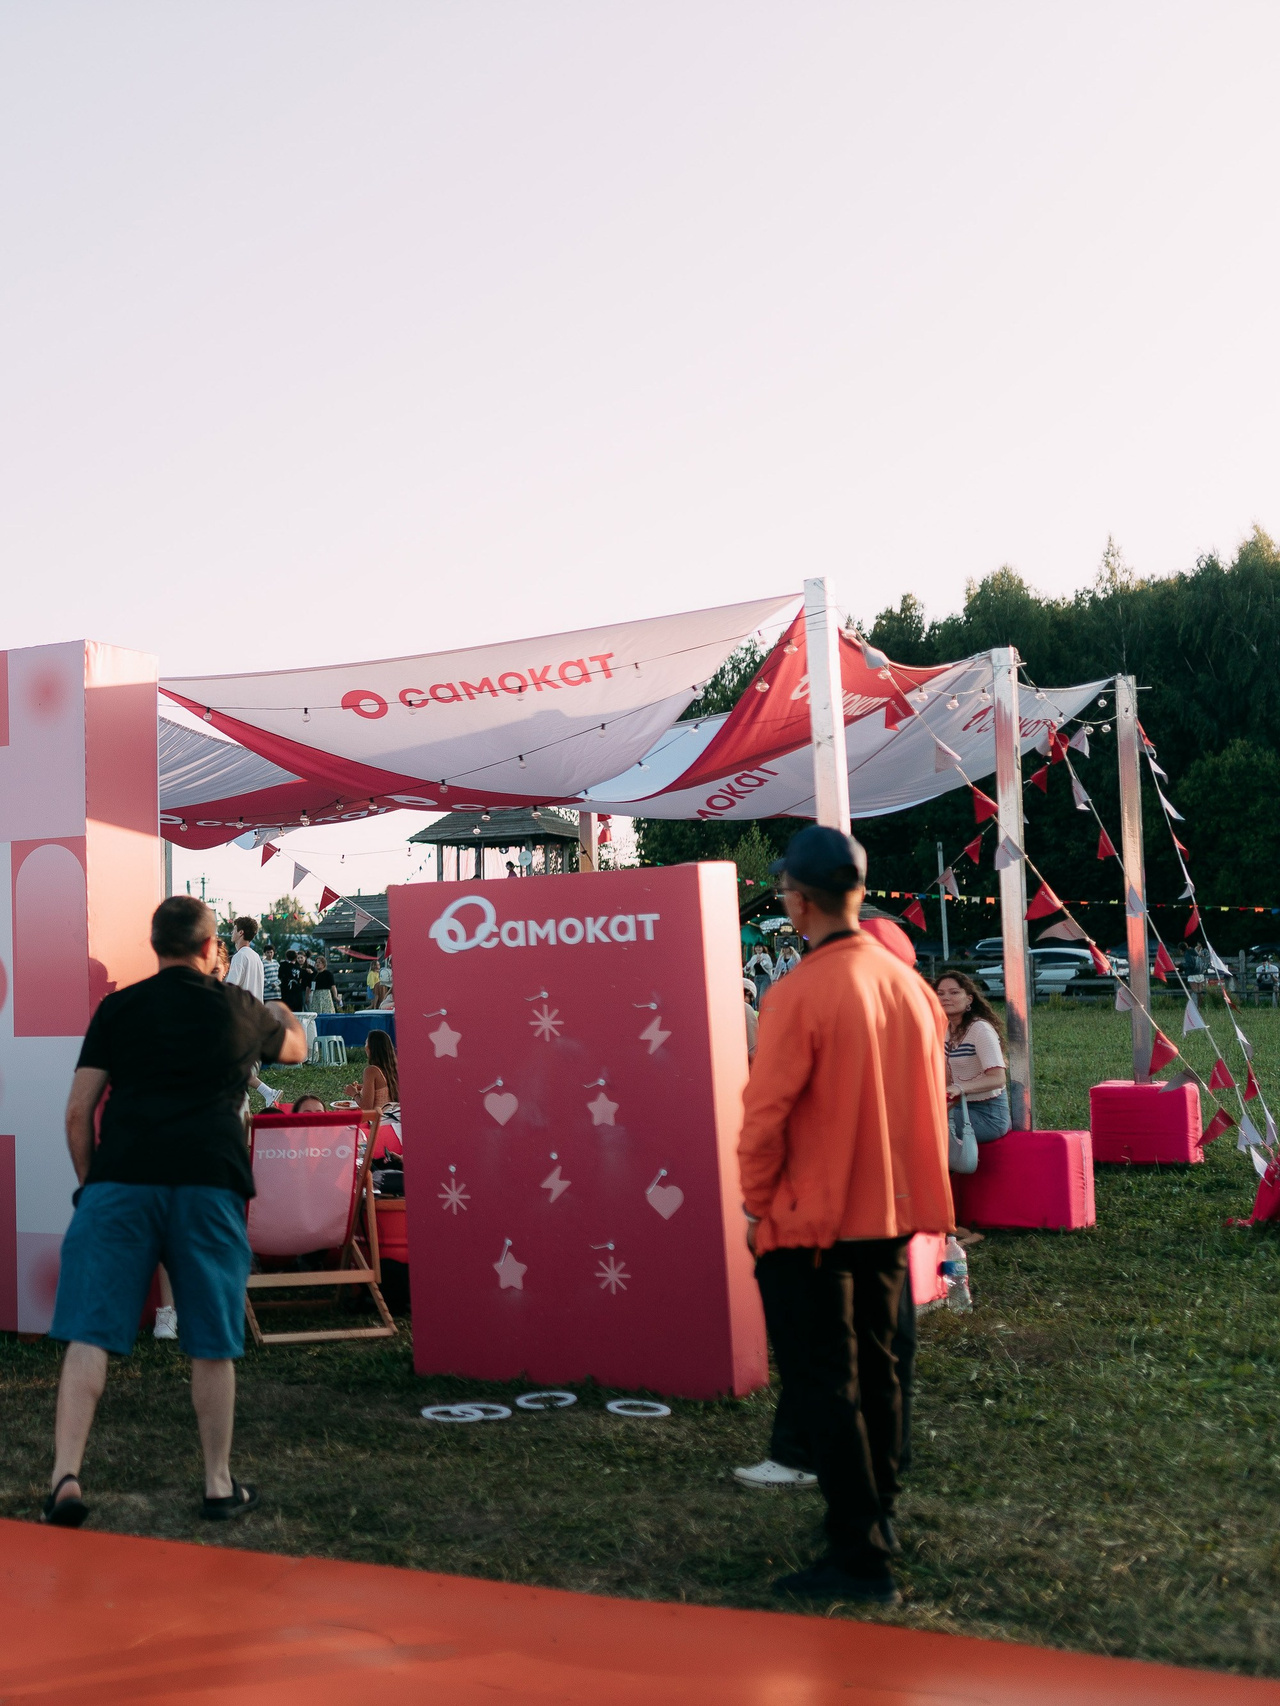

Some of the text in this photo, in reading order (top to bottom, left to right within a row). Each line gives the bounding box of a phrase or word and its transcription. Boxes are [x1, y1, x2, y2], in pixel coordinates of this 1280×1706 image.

[398, 652, 614, 709] самокат
[696, 764, 779, 819] мокат
[475, 913, 660, 949] самокат
